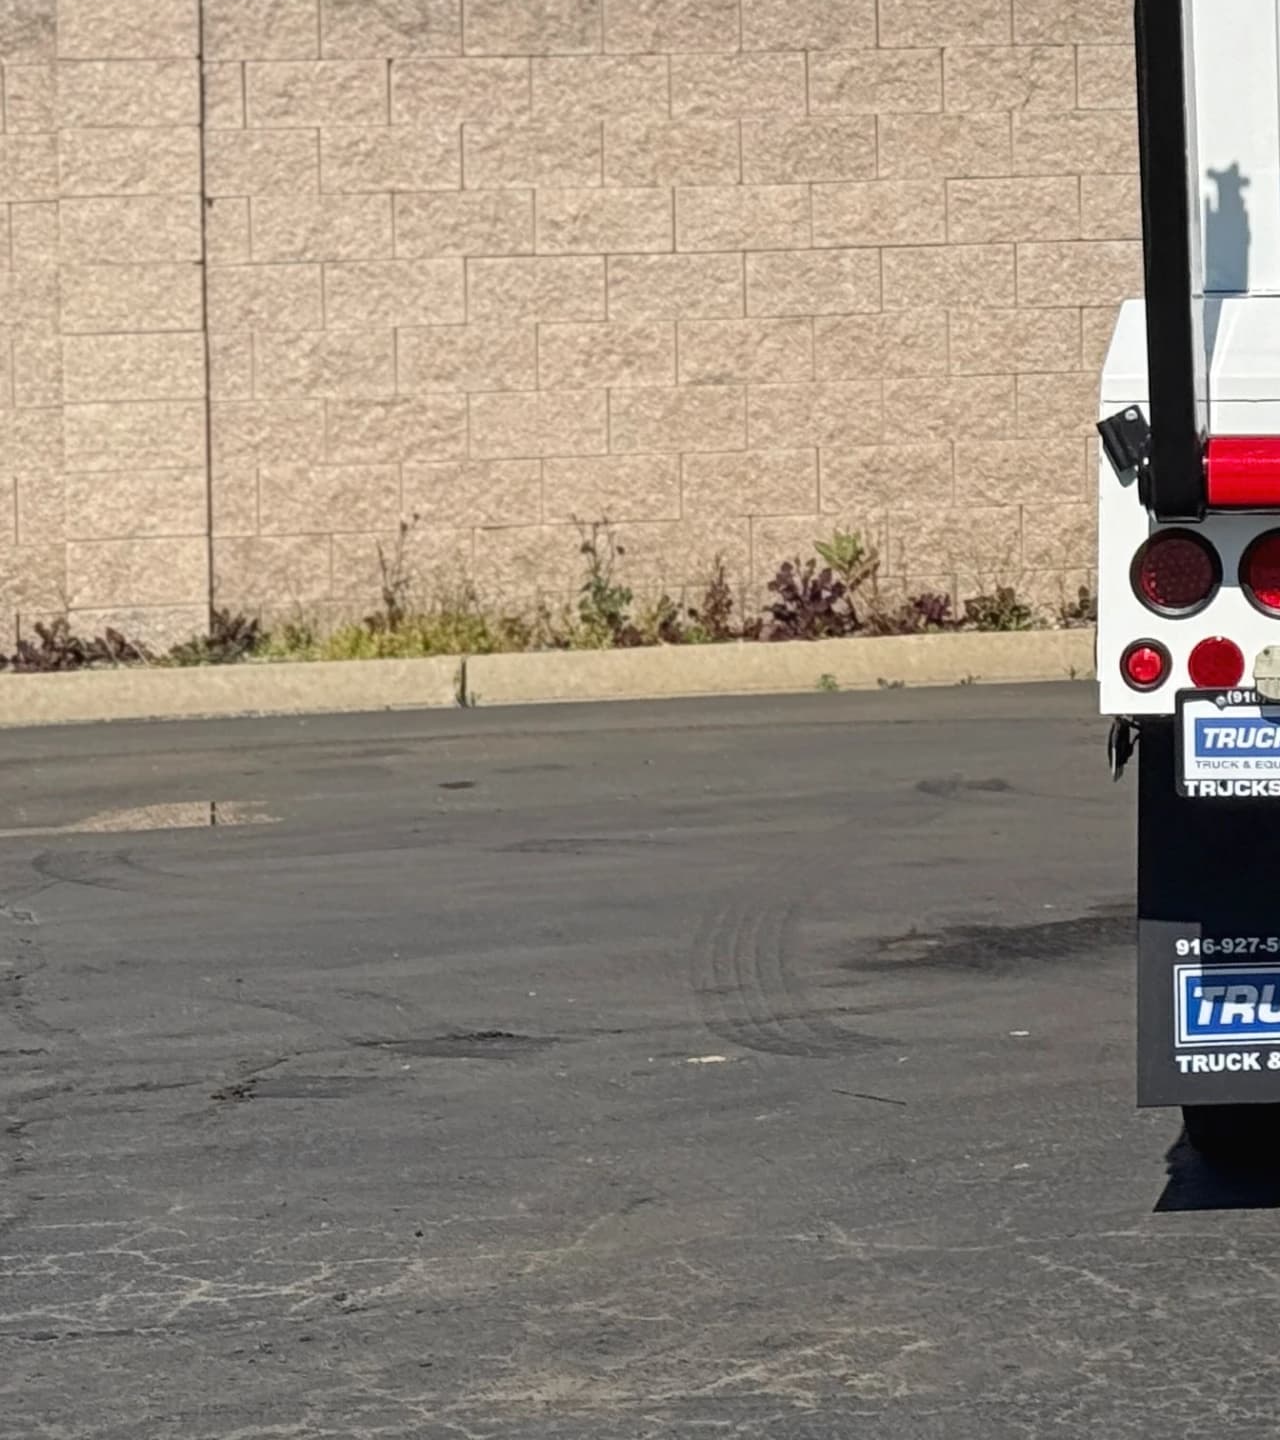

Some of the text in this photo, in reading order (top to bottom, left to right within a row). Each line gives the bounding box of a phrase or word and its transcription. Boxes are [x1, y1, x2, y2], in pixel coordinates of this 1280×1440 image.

[1195, 760, 1239, 770] TRUCK
[1243, 760, 1251, 770] &
[1175, 1052, 1262, 1073] TRUCK
